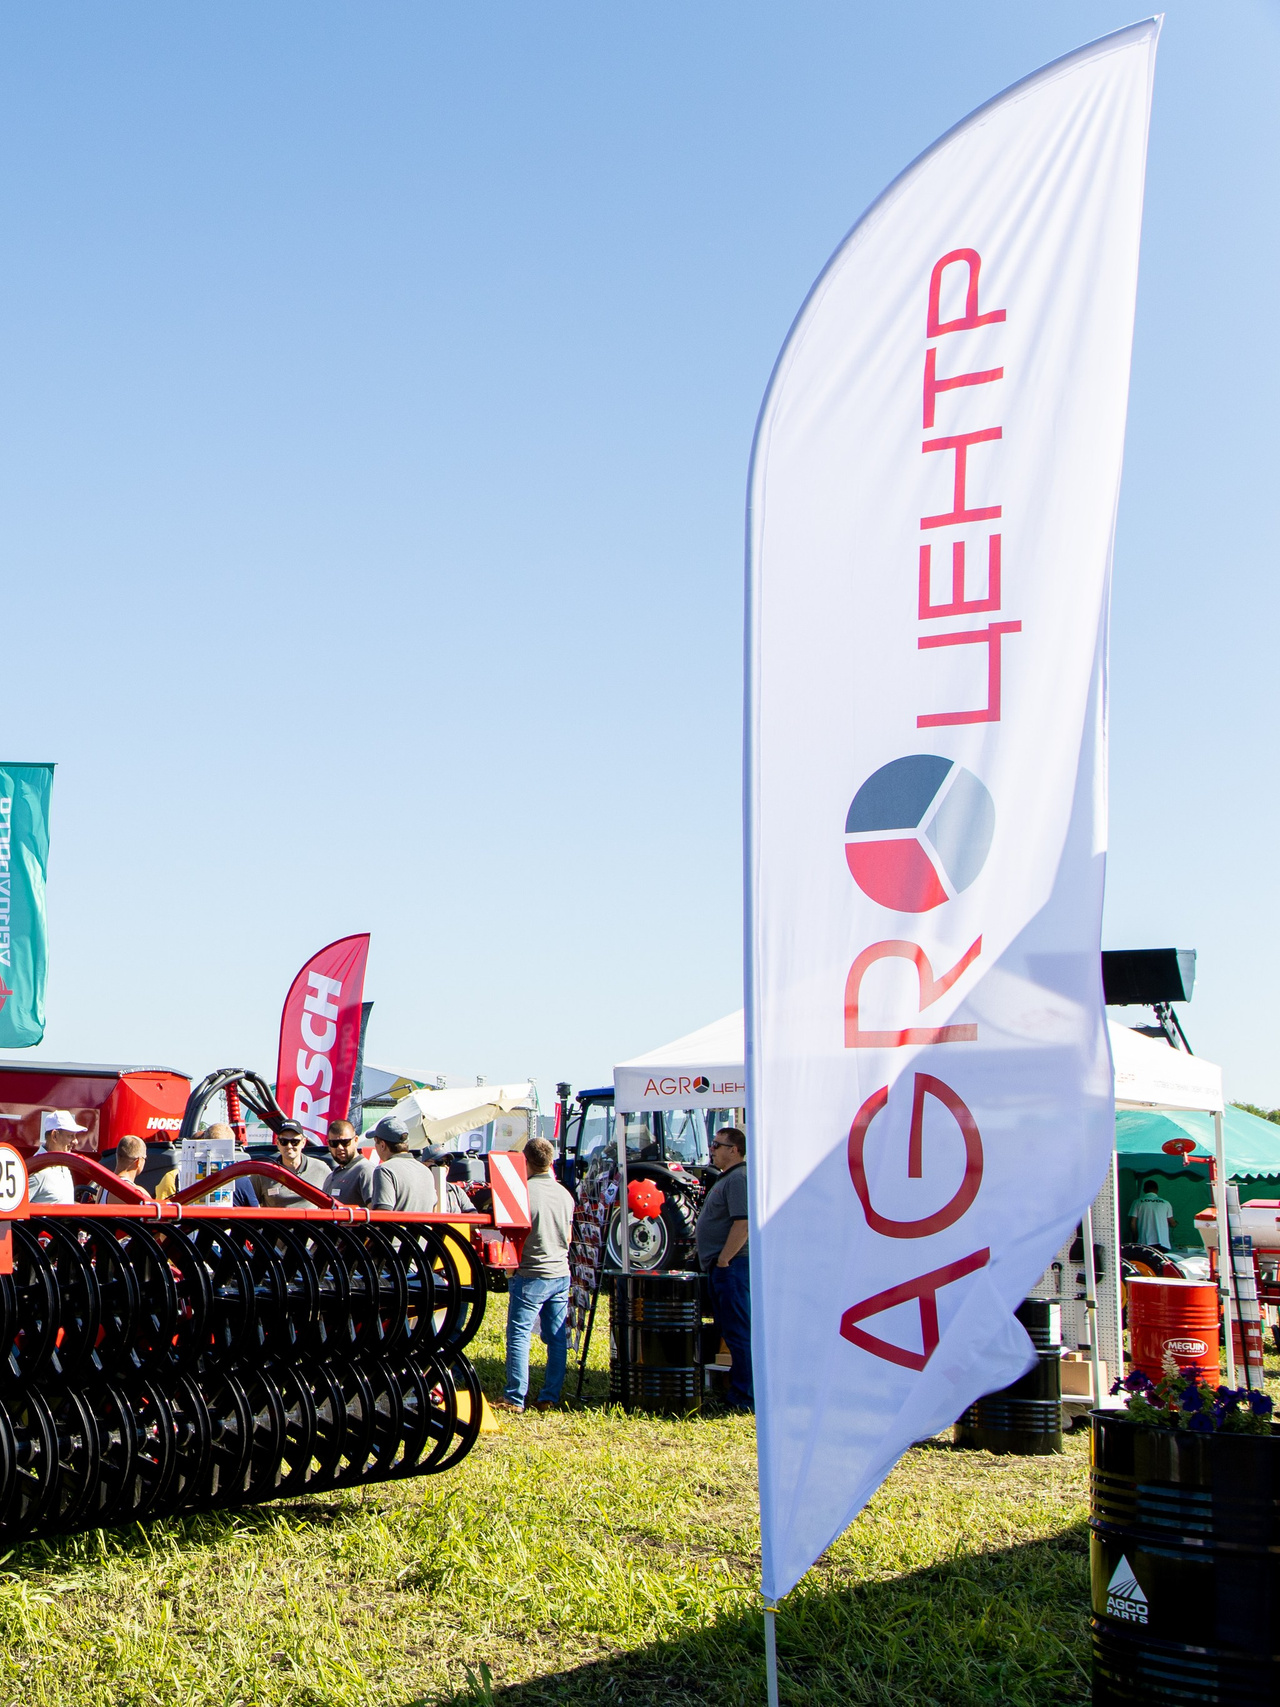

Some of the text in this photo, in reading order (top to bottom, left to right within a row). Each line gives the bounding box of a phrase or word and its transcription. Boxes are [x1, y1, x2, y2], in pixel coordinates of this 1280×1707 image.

[292, 970, 343, 1146] RSCH
[712, 1082, 746, 1095] ЦЕН
[146, 1117, 183, 1131] HORS
[1167, 1341, 1205, 1351] MEGUIN
[1107, 1596, 1149, 1616] AGCO
[1106, 1606, 1149, 1625] PARTS
